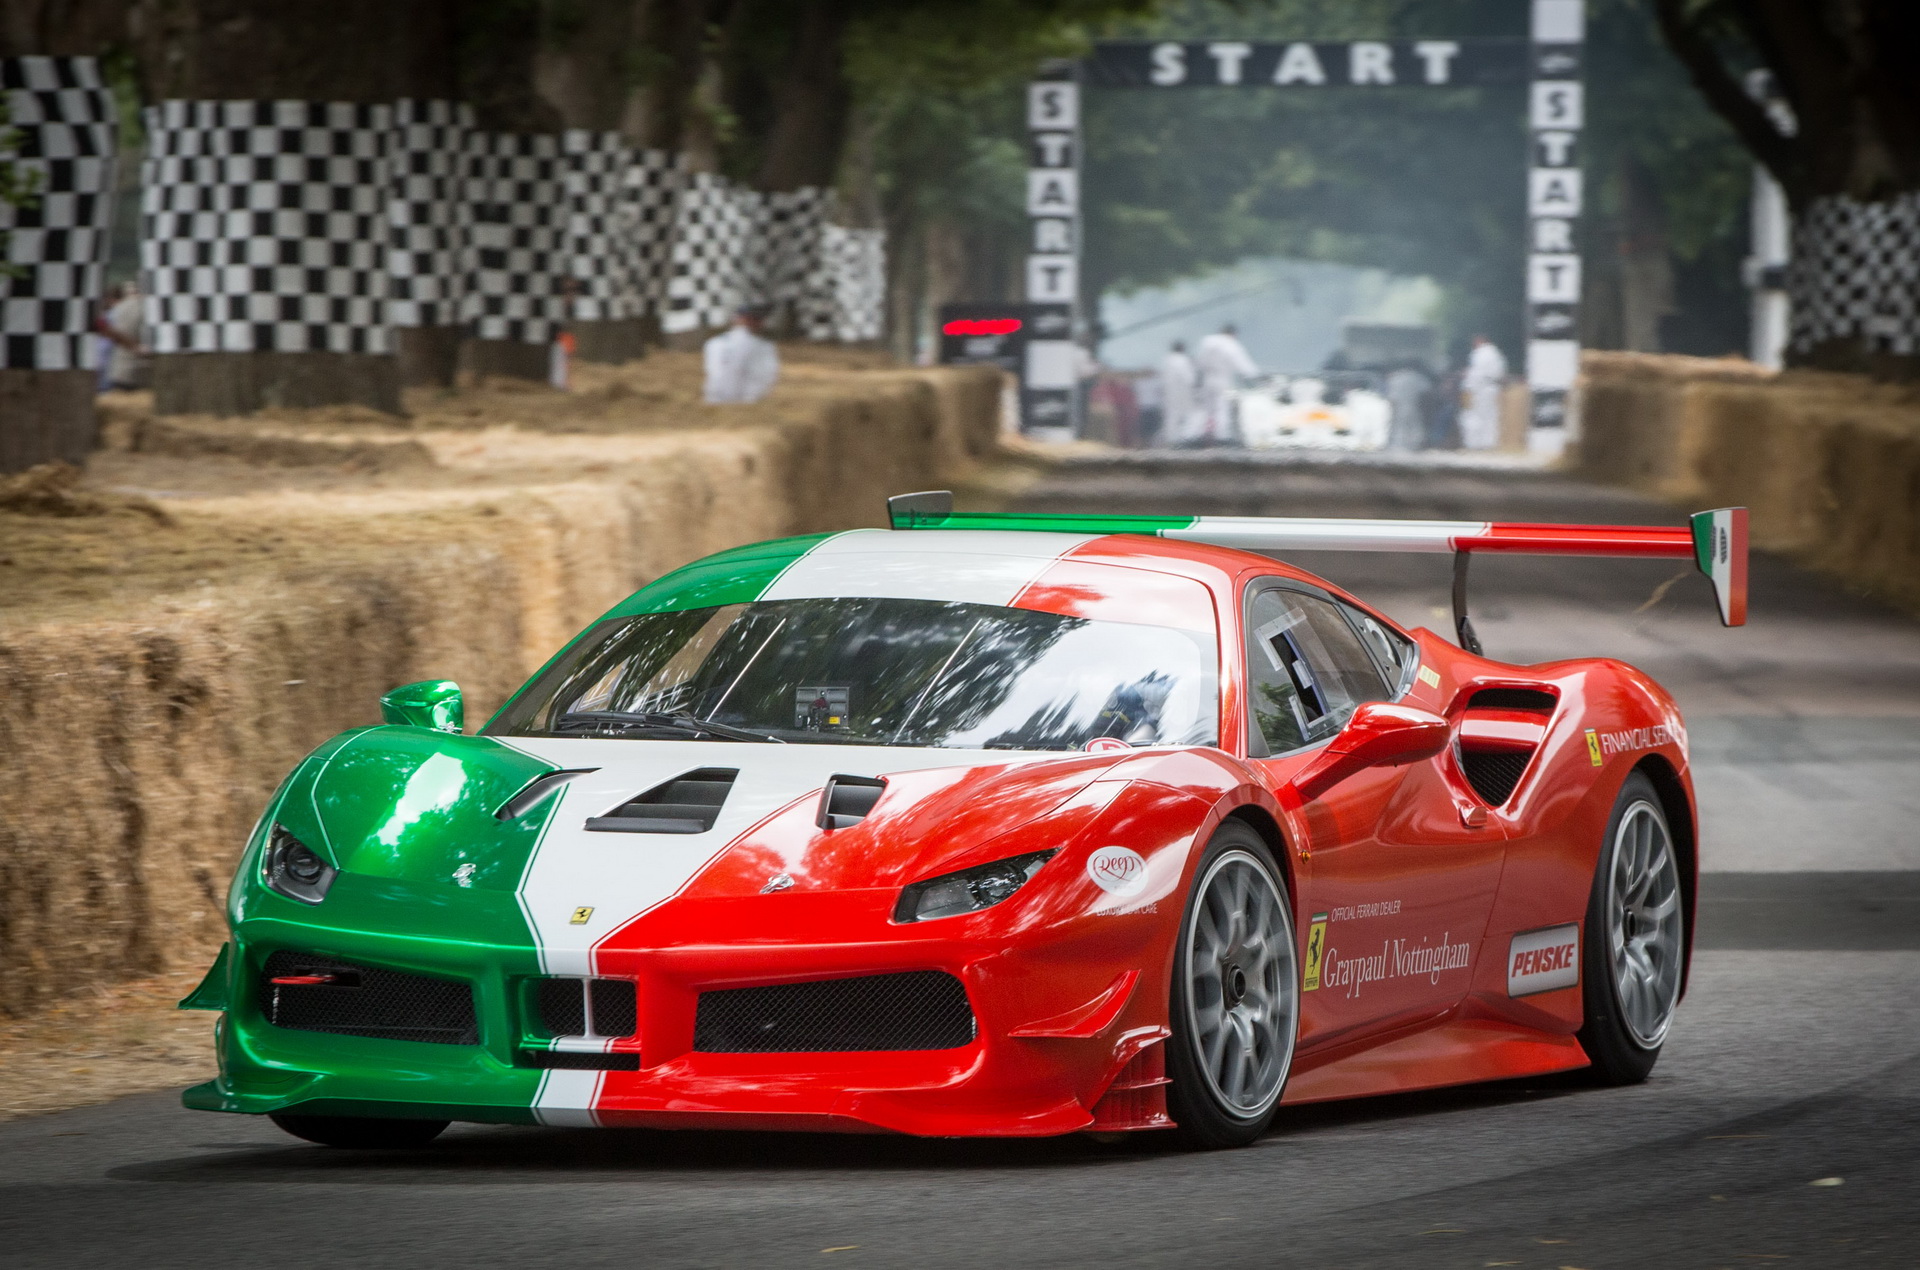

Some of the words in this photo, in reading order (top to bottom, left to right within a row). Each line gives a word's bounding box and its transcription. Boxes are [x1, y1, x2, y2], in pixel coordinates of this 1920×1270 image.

[1151, 42, 1458, 86] START
[1036, 90, 1071, 293] START
[1536, 90, 1577, 292] START
[1601, 728, 1652, 755] FINANCIAL
[1332, 906, 1356, 922] OFFICIAL
[1357, 903, 1380, 919] FERRARI
[1380, 900, 1401, 916] DEALER
[1324, 939, 1389, 999] Graypaul
[1389, 931, 1470, 986] Nottingham
[1512, 943, 1575, 978] PENSKE
